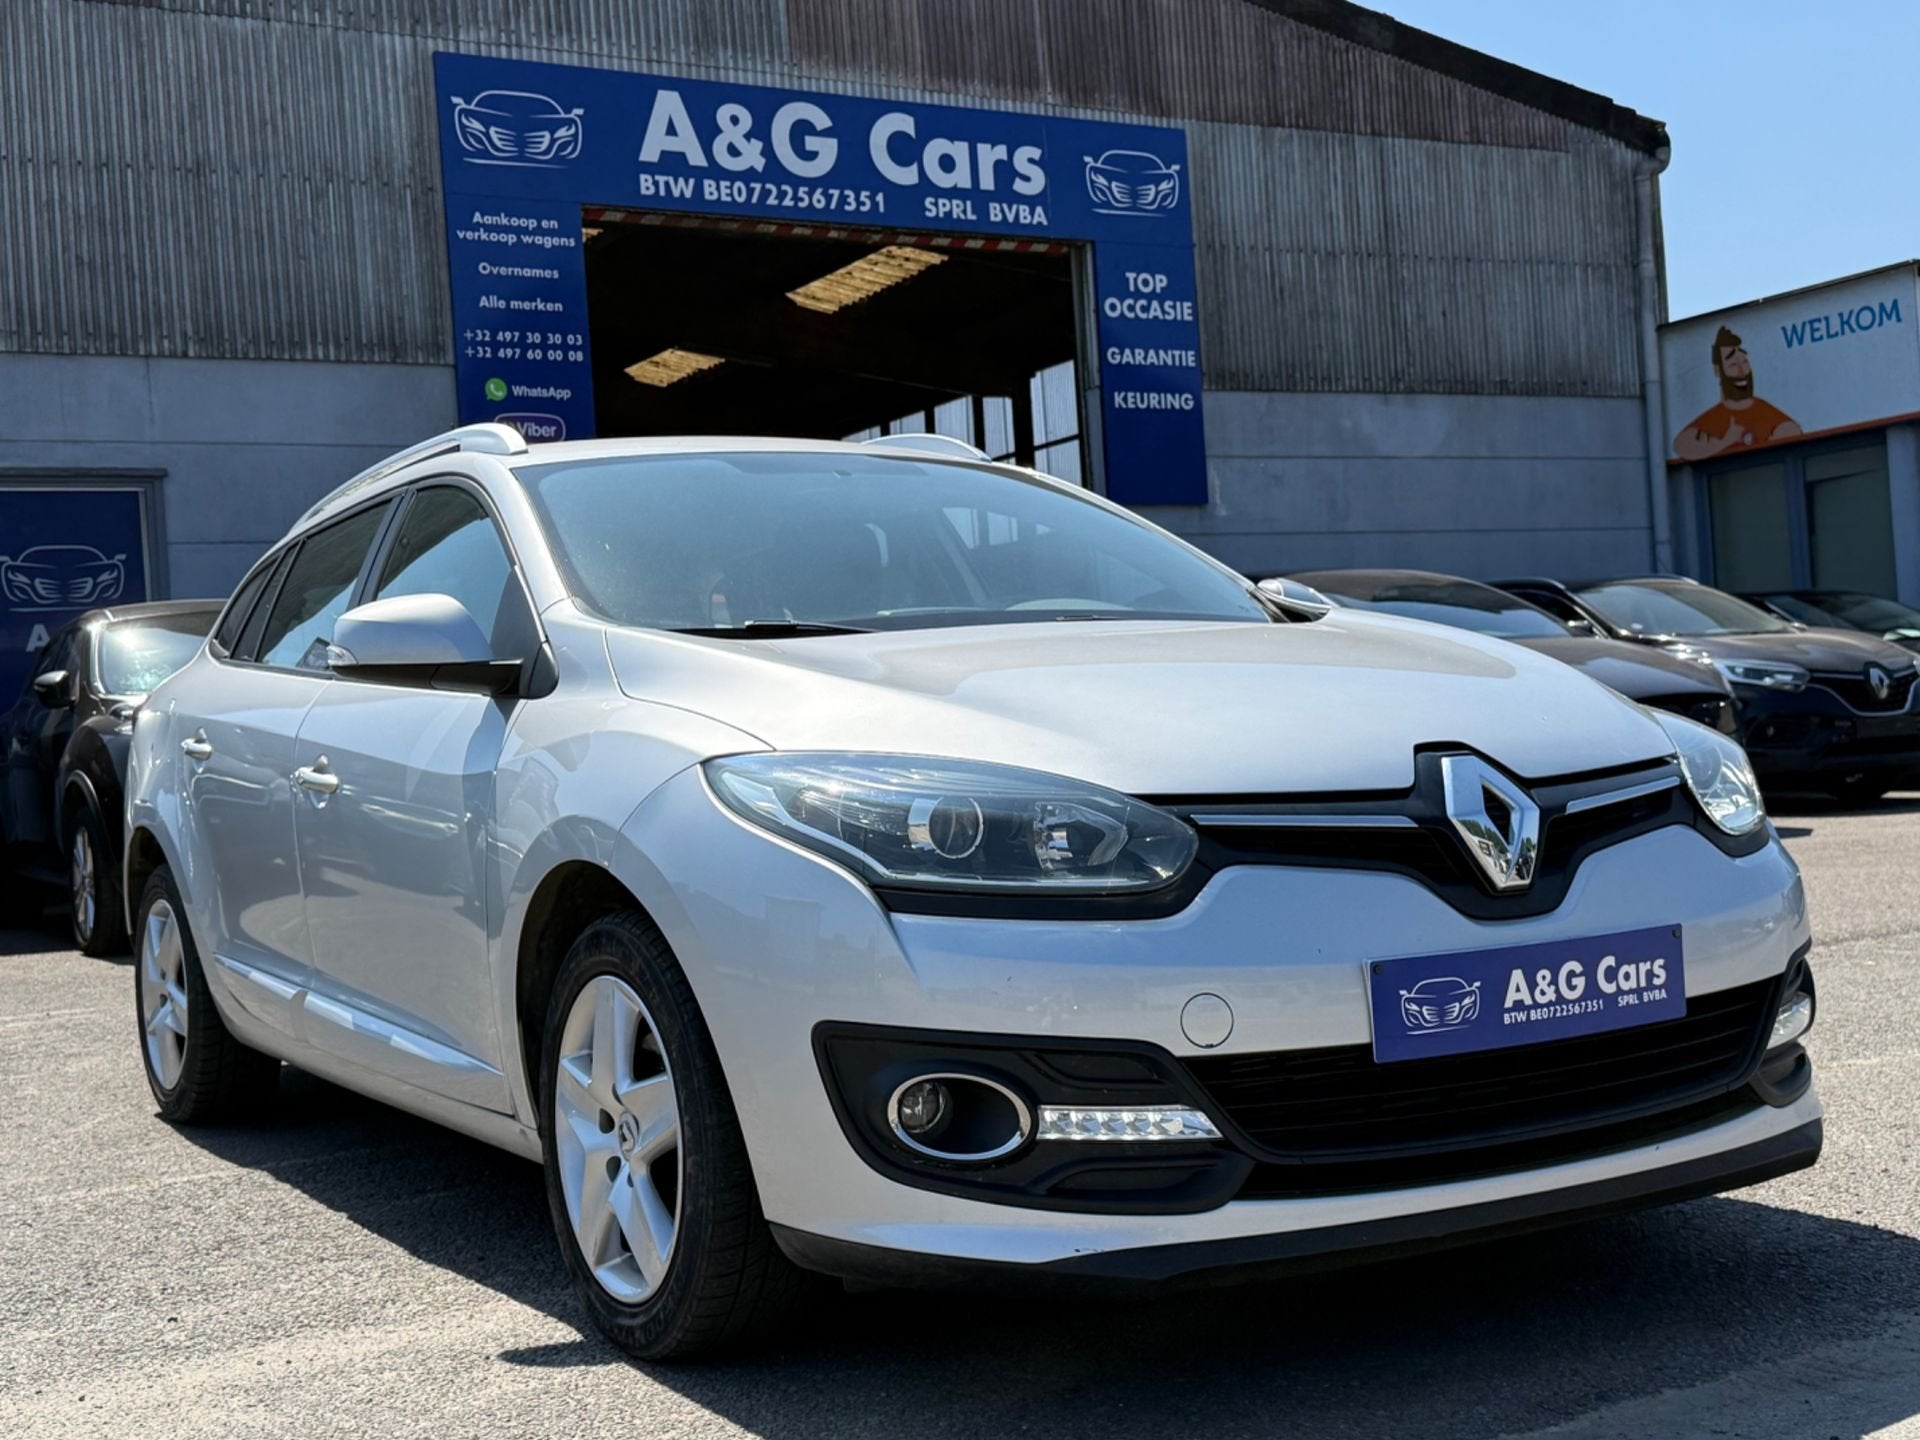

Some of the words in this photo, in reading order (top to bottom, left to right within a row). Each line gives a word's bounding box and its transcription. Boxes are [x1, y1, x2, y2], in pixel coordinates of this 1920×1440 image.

[638, 89, 838, 178] A&G
[869, 112, 1046, 196] Cars
[639, 173, 695, 199] BTW
[703, 179, 885, 213] BE0722567351
[924, 197, 977, 221] SPRL
[989, 202, 1048, 226] BVBA
[472, 211, 537, 230] Aankoop
[541, 219, 558, 229] en
[456, 228, 517, 245] verkoop
[521, 234, 575, 248] wagens
[478, 262, 559, 279] Overnames
[1125, 272, 1168, 293] TOP
[479, 295, 506, 309] Alle
[510, 298, 563, 312] merken
[1104, 297, 1193, 321] OCCASIE
[1781, 299, 1902, 348] WELKOM
[464, 329, 491, 341] +32
[496, 331, 520, 343] 497
[526, 332, 541, 343] 30
[547, 333, 562, 344] 30
[567, 334, 583, 345] 03
[465, 346, 492, 358] +32
[497, 348, 520, 359] 497
[526, 349, 542, 360] 60
[547, 350, 563, 361] 00
[568, 351, 584, 362] 08
[1107, 347, 1196, 367] GARANTIE
[511, 385, 571, 400] WhatsApp
[1114, 392, 1194, 410] KEURING
[518, 421, 557, 437] Viber
[1504, 960, 1586, 1008] A&G
[1597, 955, 1667, 994] Cars
[1504, 1011, 1528, 1025] BTW
[1530, 999, 1604, 1021] BE0722567351
[1618, 995, 1639, 1007] SPRL
[1643, 988, 1667, 1003] BVBA
